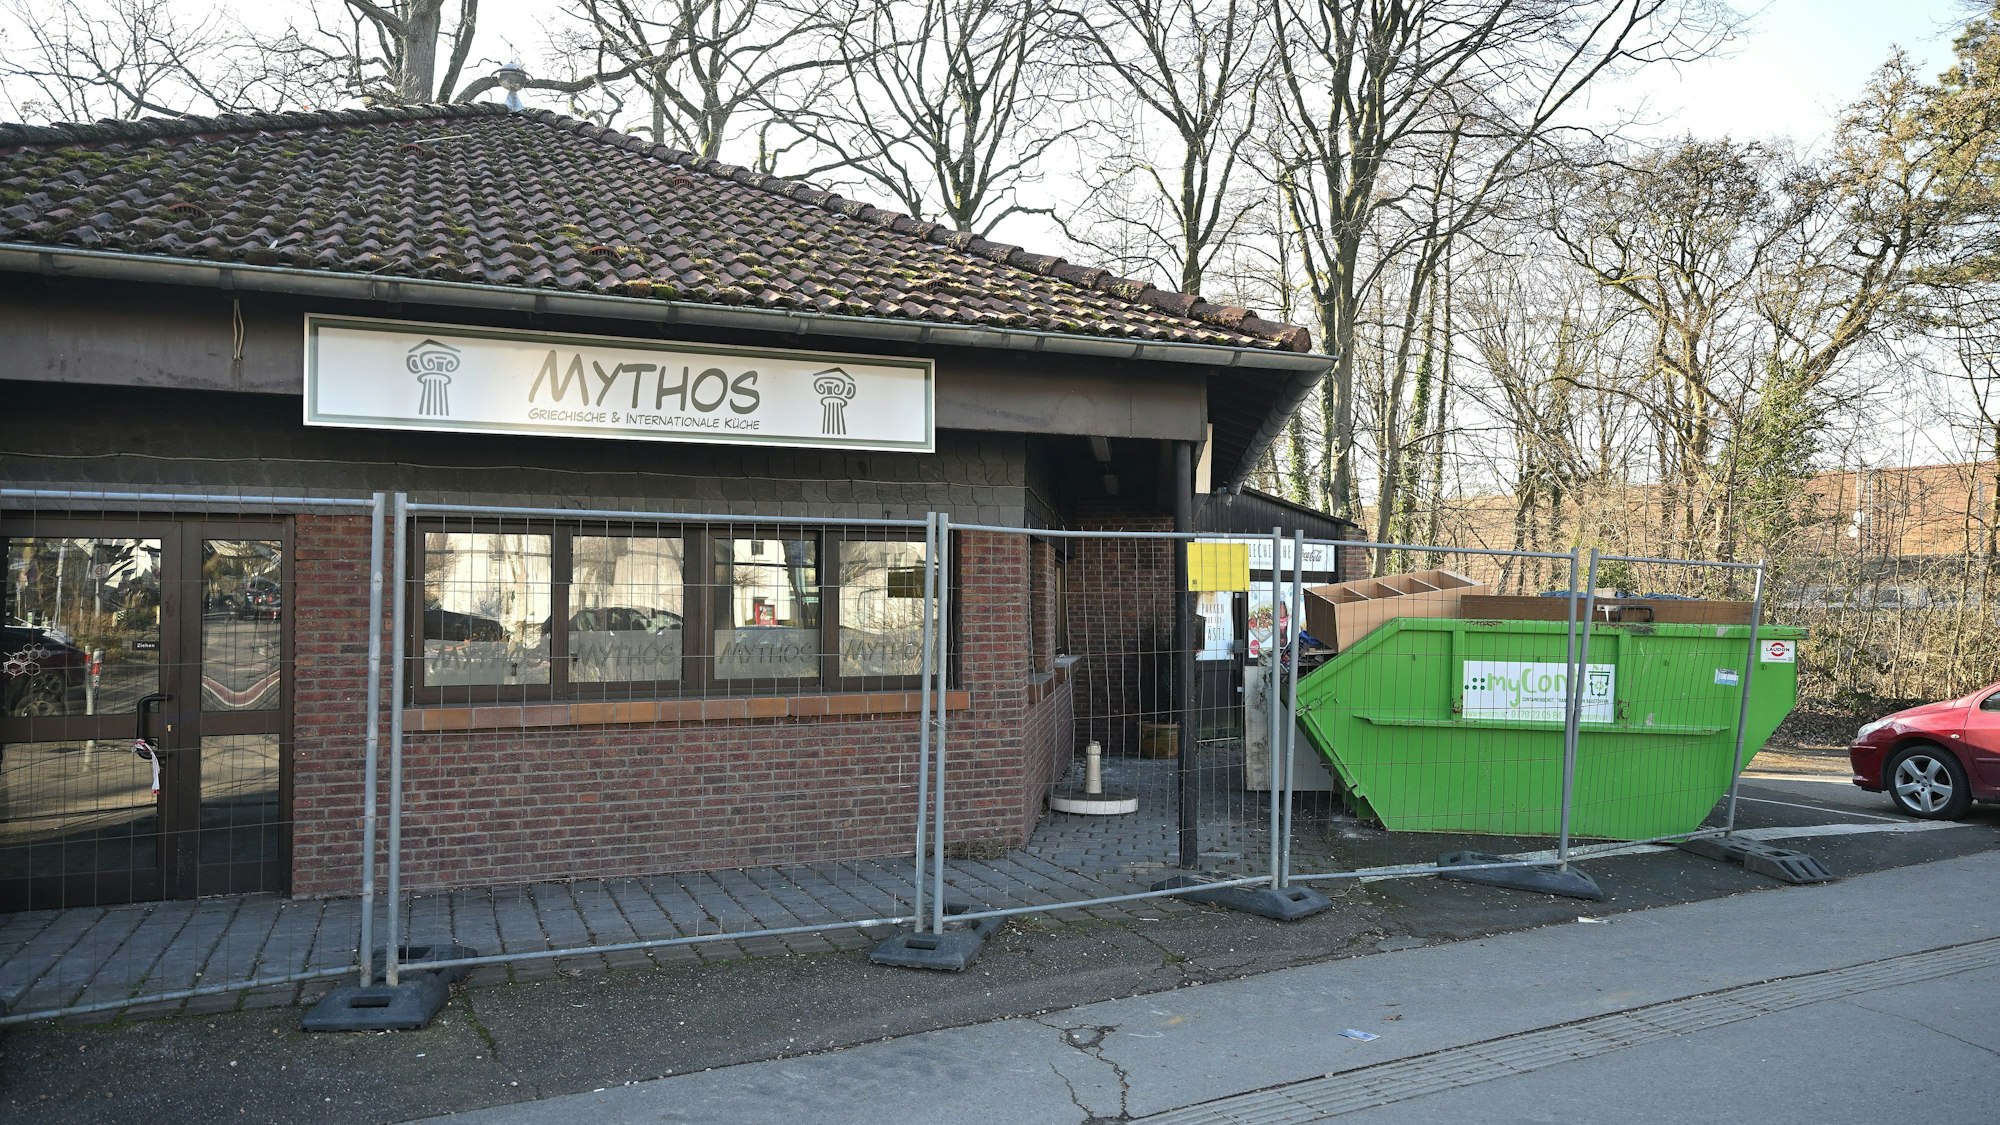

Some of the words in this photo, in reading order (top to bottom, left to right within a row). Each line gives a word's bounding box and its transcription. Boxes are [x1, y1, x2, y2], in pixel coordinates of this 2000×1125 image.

[528, 349, 760, 415] MYTHOS
[528, 407, 606, 424] GRIECHISCHE
[611, 411, 621, 425] &
[626, 412, 720, 429] INTERNATIONALE
[724, 416, 760, 431] KÜCHE
[1207, 625, 1226, 642] ÄSTE
[718, 640, 814, 665] MYTHOS
[842, 638, 938, 663] MYTHO
[1487, 667, 1587, 708] myCon
